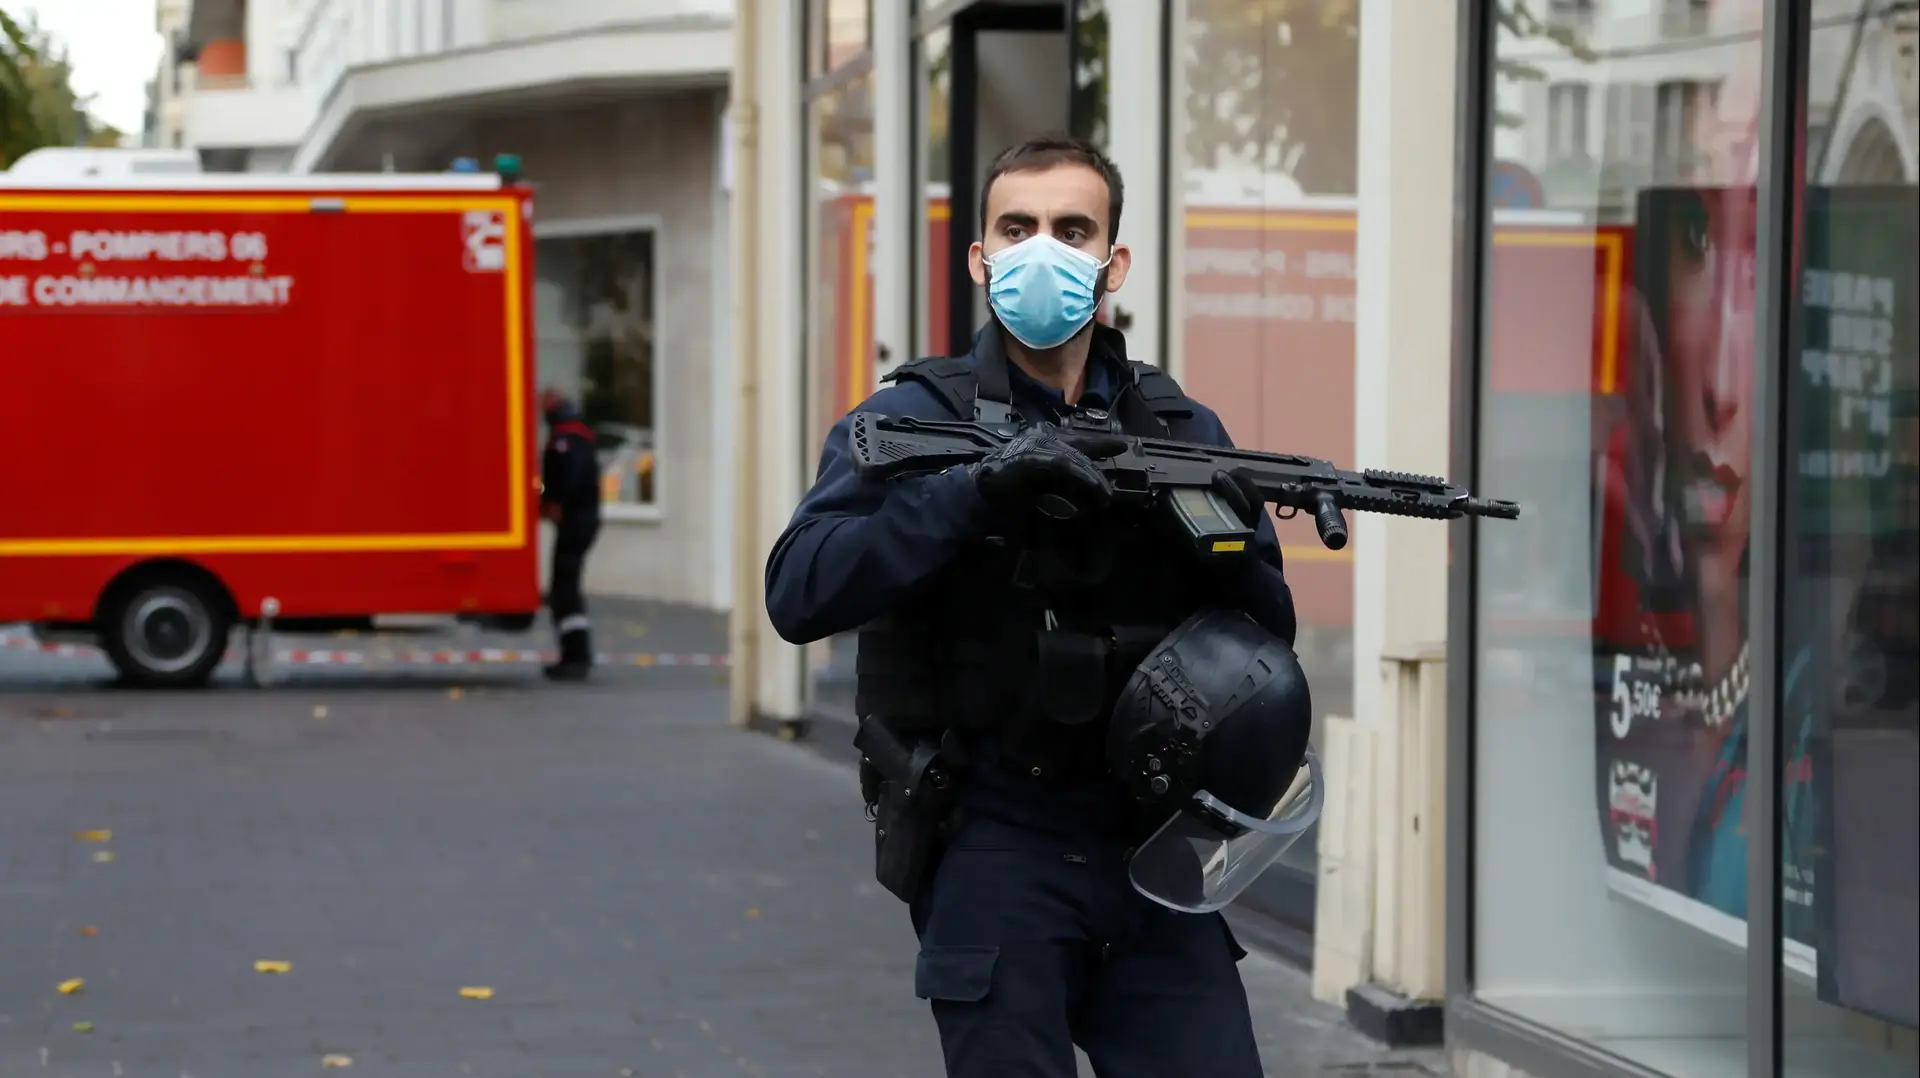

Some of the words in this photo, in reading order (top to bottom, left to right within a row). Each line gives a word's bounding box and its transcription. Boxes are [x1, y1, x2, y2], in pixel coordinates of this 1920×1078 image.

[0, 230, 48, 260] RS
[69, 230, 226, 260] POMPIERS
[230, 230, 267, 261] 06
[34, 275, 295, 306] COMMANDEMENT
